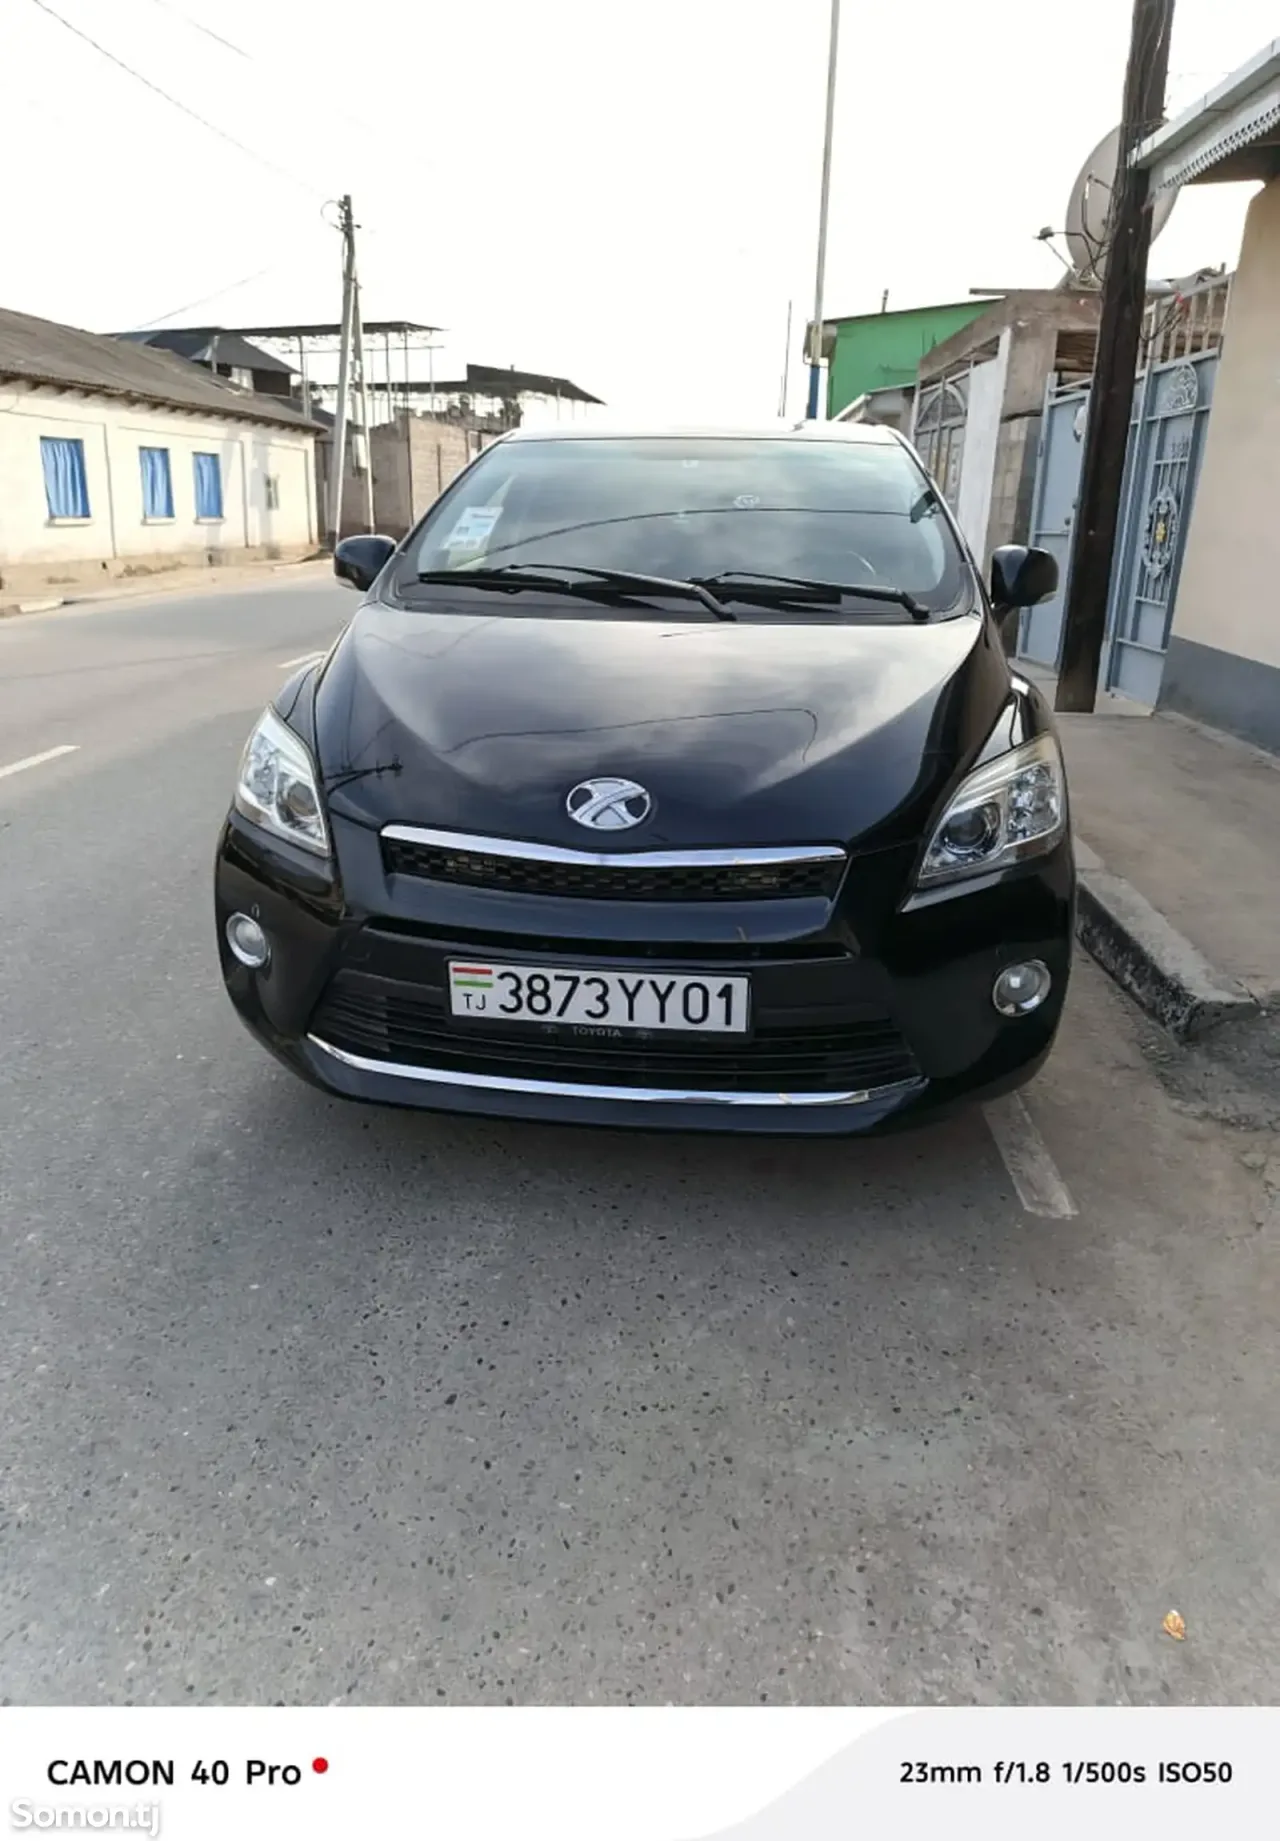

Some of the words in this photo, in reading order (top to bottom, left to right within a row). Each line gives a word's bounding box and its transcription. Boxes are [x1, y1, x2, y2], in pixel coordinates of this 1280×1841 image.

[462, 993, 487, 1011] TJ
[496, 971, 734, 1027] 3873YY01
[572, 1025, 623, 1038] TOYOTA
